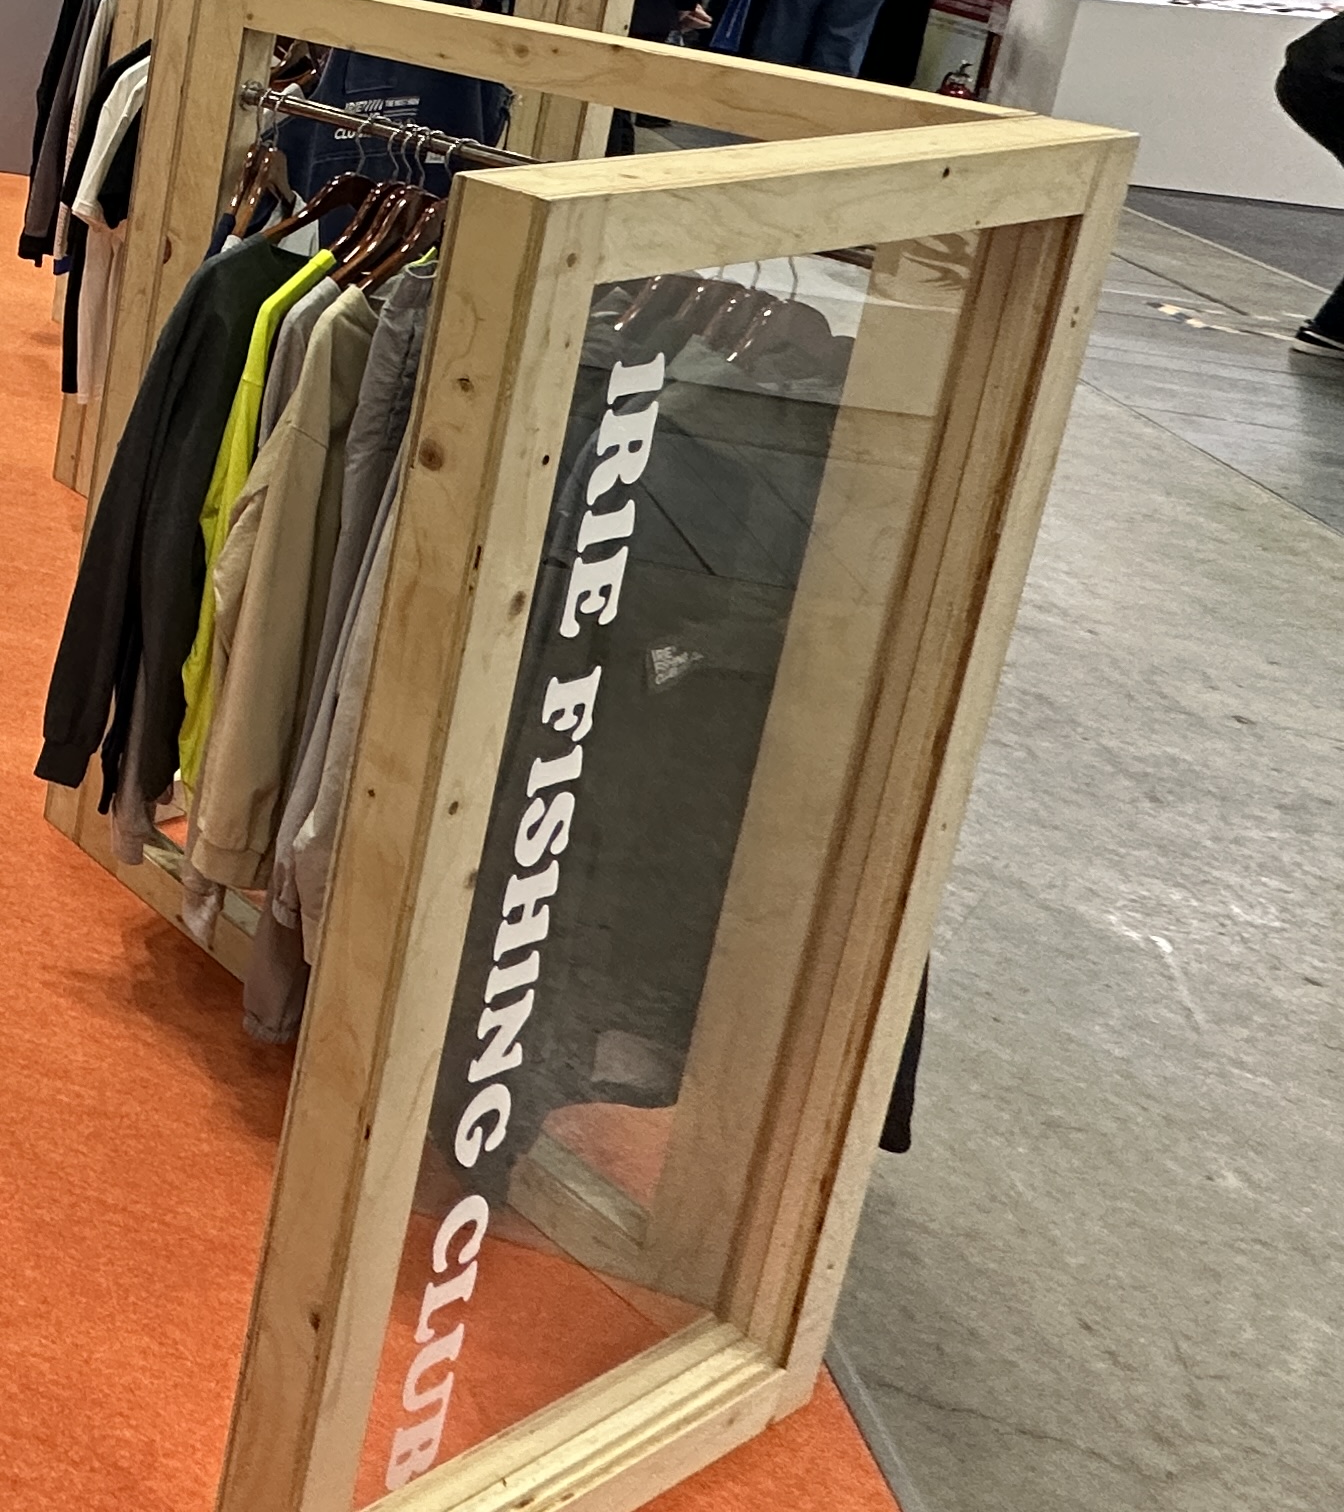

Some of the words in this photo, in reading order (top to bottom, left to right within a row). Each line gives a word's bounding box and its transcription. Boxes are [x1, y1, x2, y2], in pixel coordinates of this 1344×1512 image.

[560, 352, 665, 638] IRIE
[454, 665, 602, 1168] FISHING
[385, 1194, 490, 1492] CLUB
